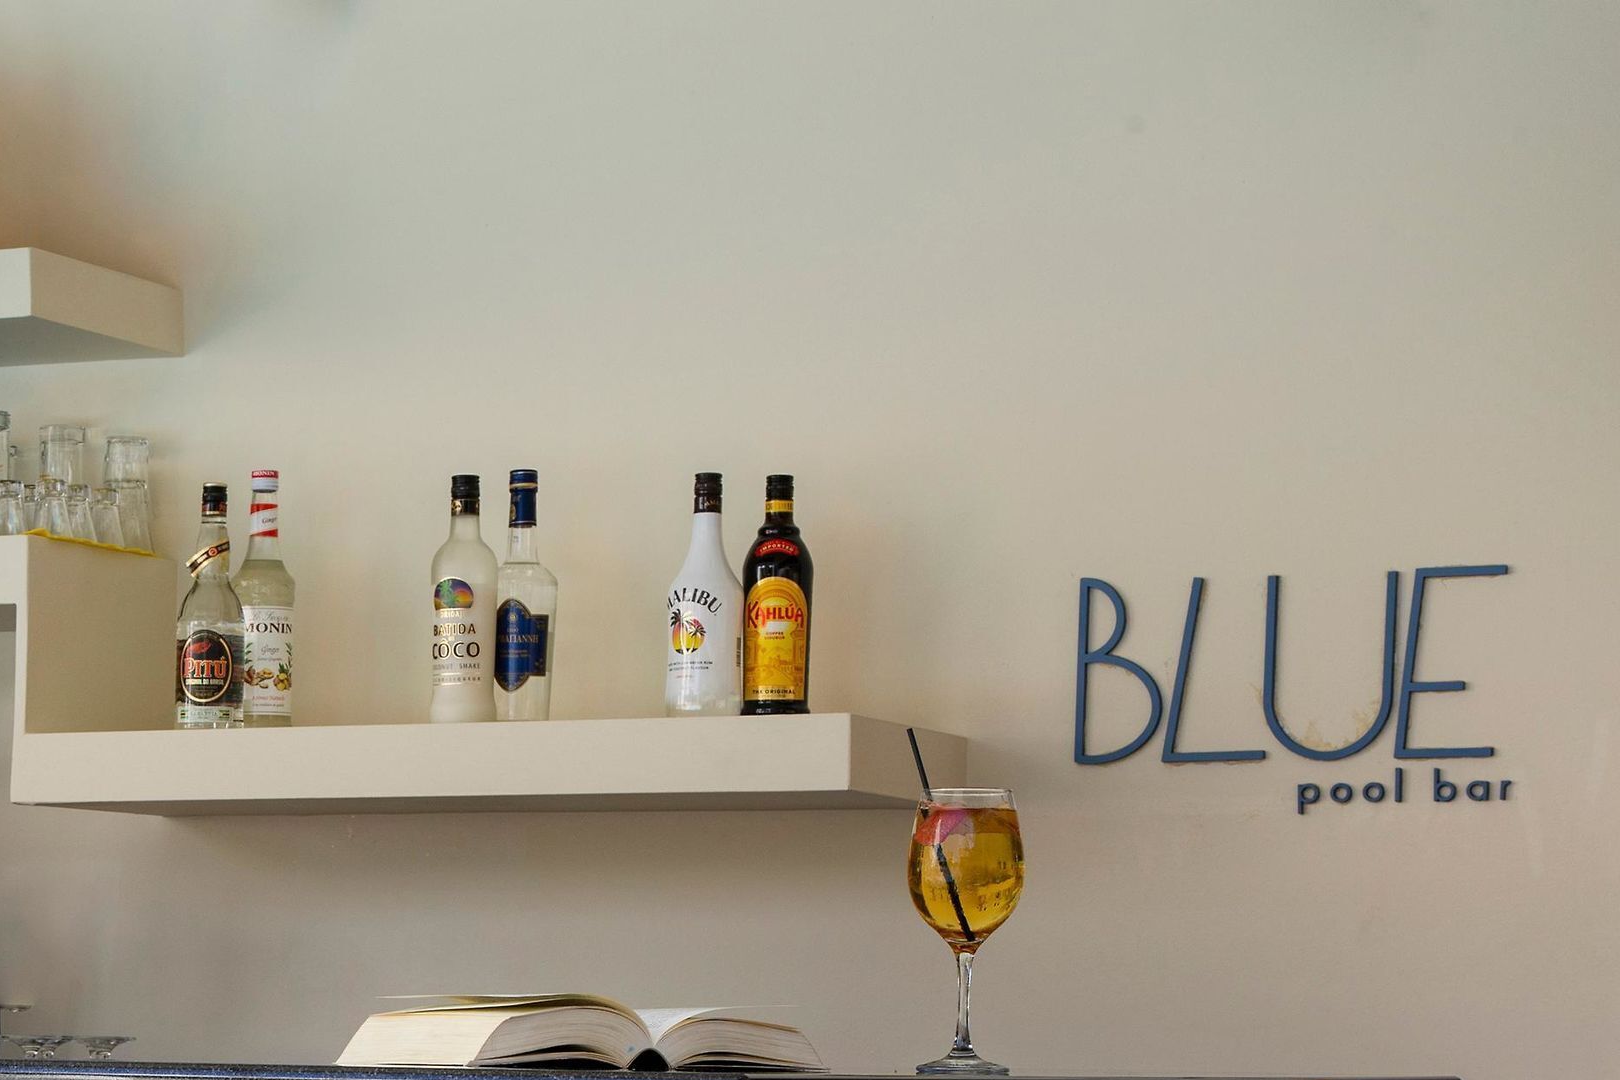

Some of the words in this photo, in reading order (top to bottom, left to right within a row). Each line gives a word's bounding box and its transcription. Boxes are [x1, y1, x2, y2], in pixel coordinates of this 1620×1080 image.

[433, 623, 477, 637] BATIDA
[746, 599, 805, 630] KAHLÚA
[183, 655, 228, 679] PITÚ
[1074, 564, 1510, 765] BLUE
[1297, 767, 1404, 815] pool
[1433, 767, 1514, 803] bar
